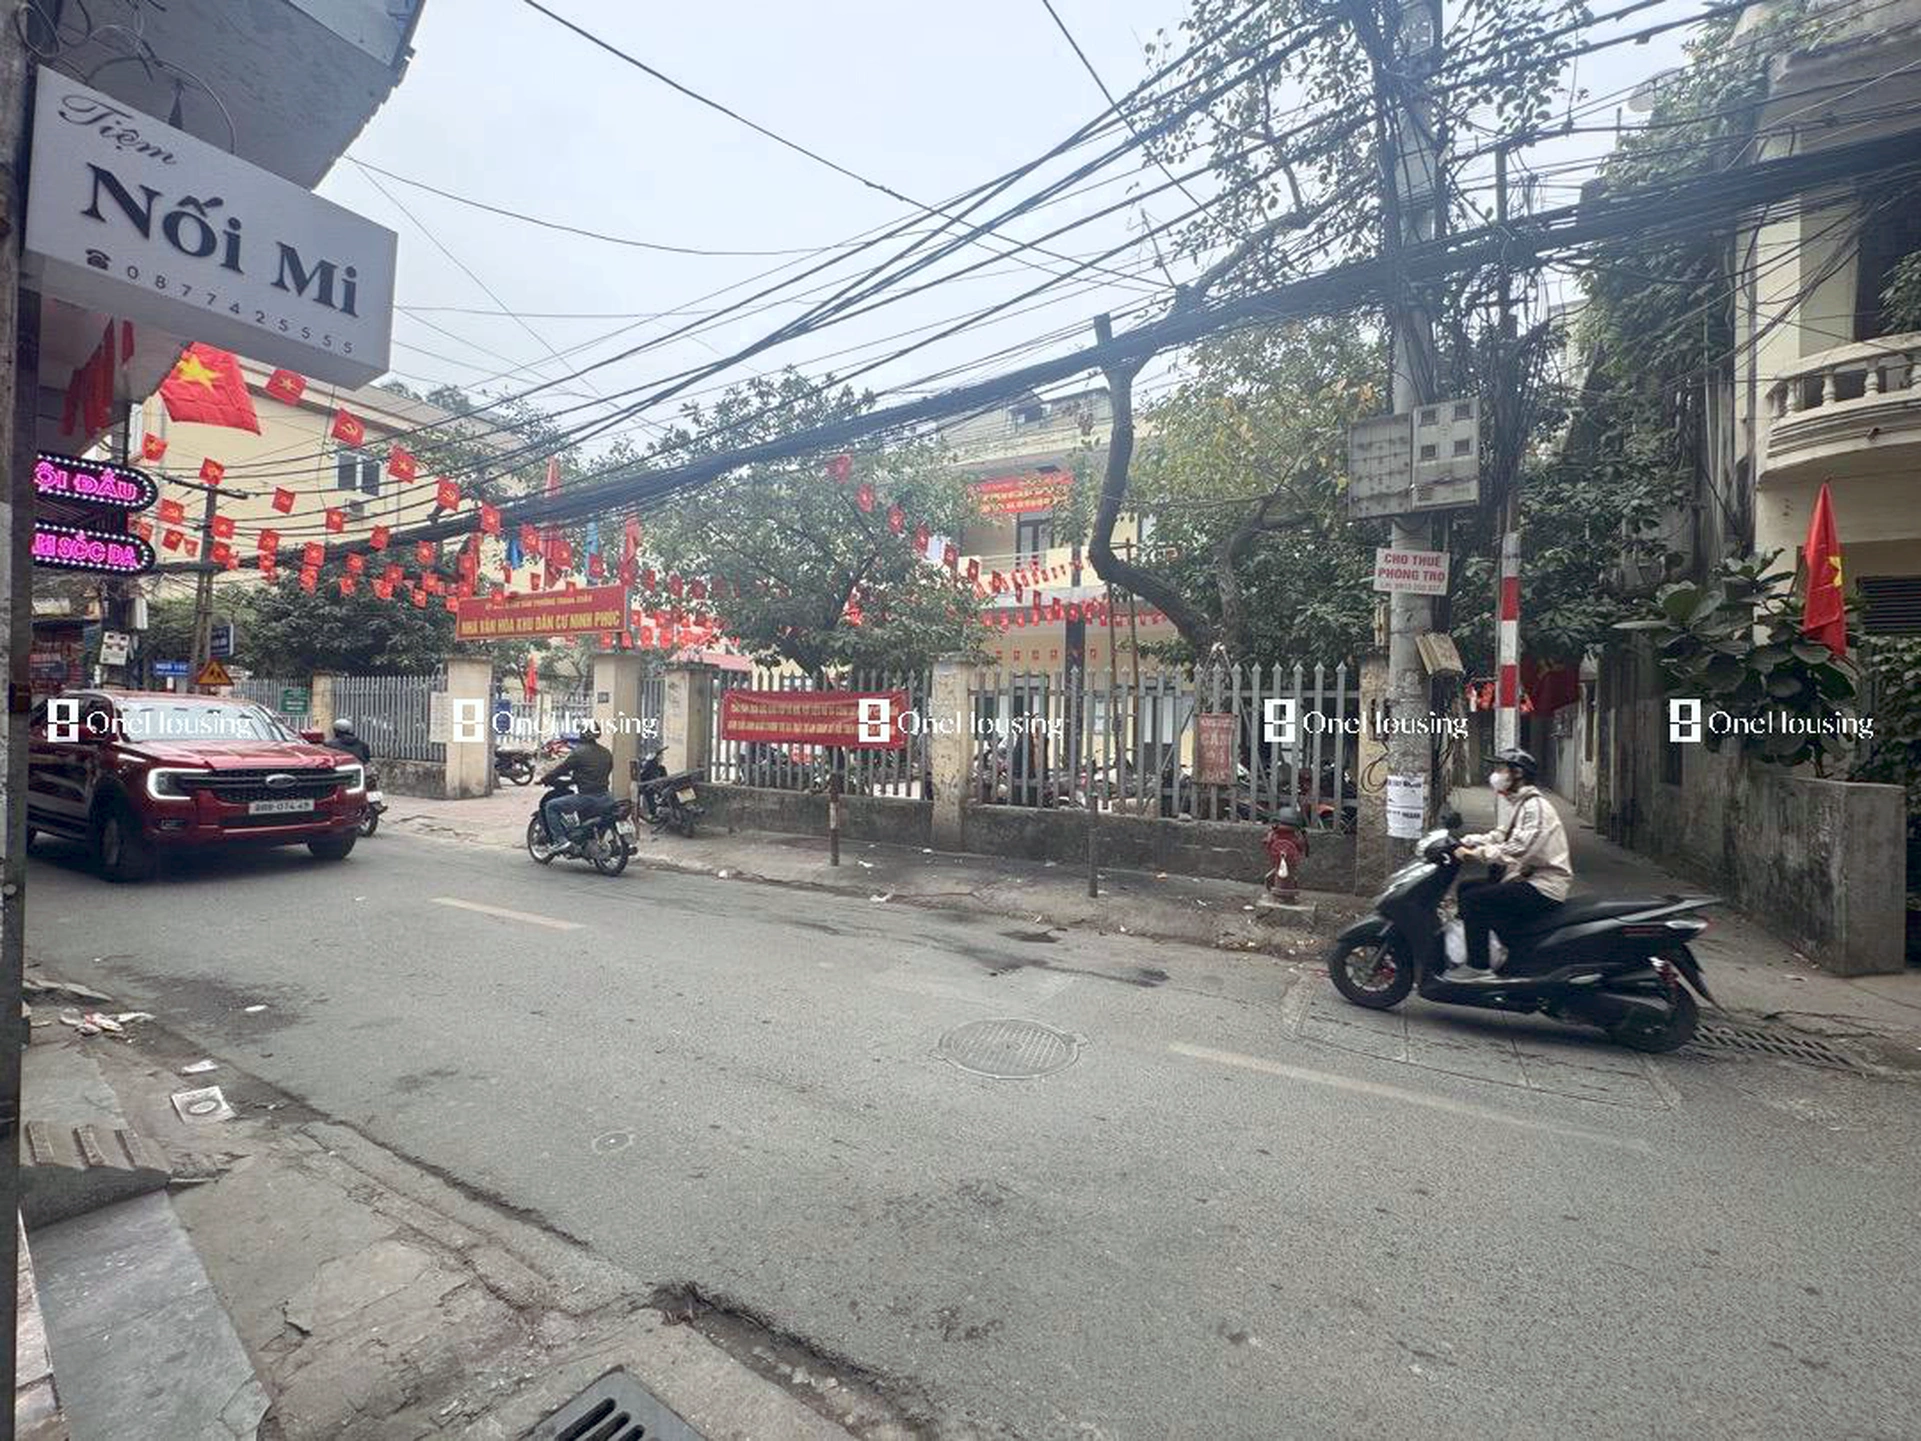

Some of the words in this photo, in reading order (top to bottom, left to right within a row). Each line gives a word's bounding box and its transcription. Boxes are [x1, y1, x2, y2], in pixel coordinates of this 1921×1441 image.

[57, 94, 178, 166] Tiệm
[80, 162, 246, 276] Nối
[271, 241, 360, 318] Mi
[1385, 553, 1409, 565] CHO
